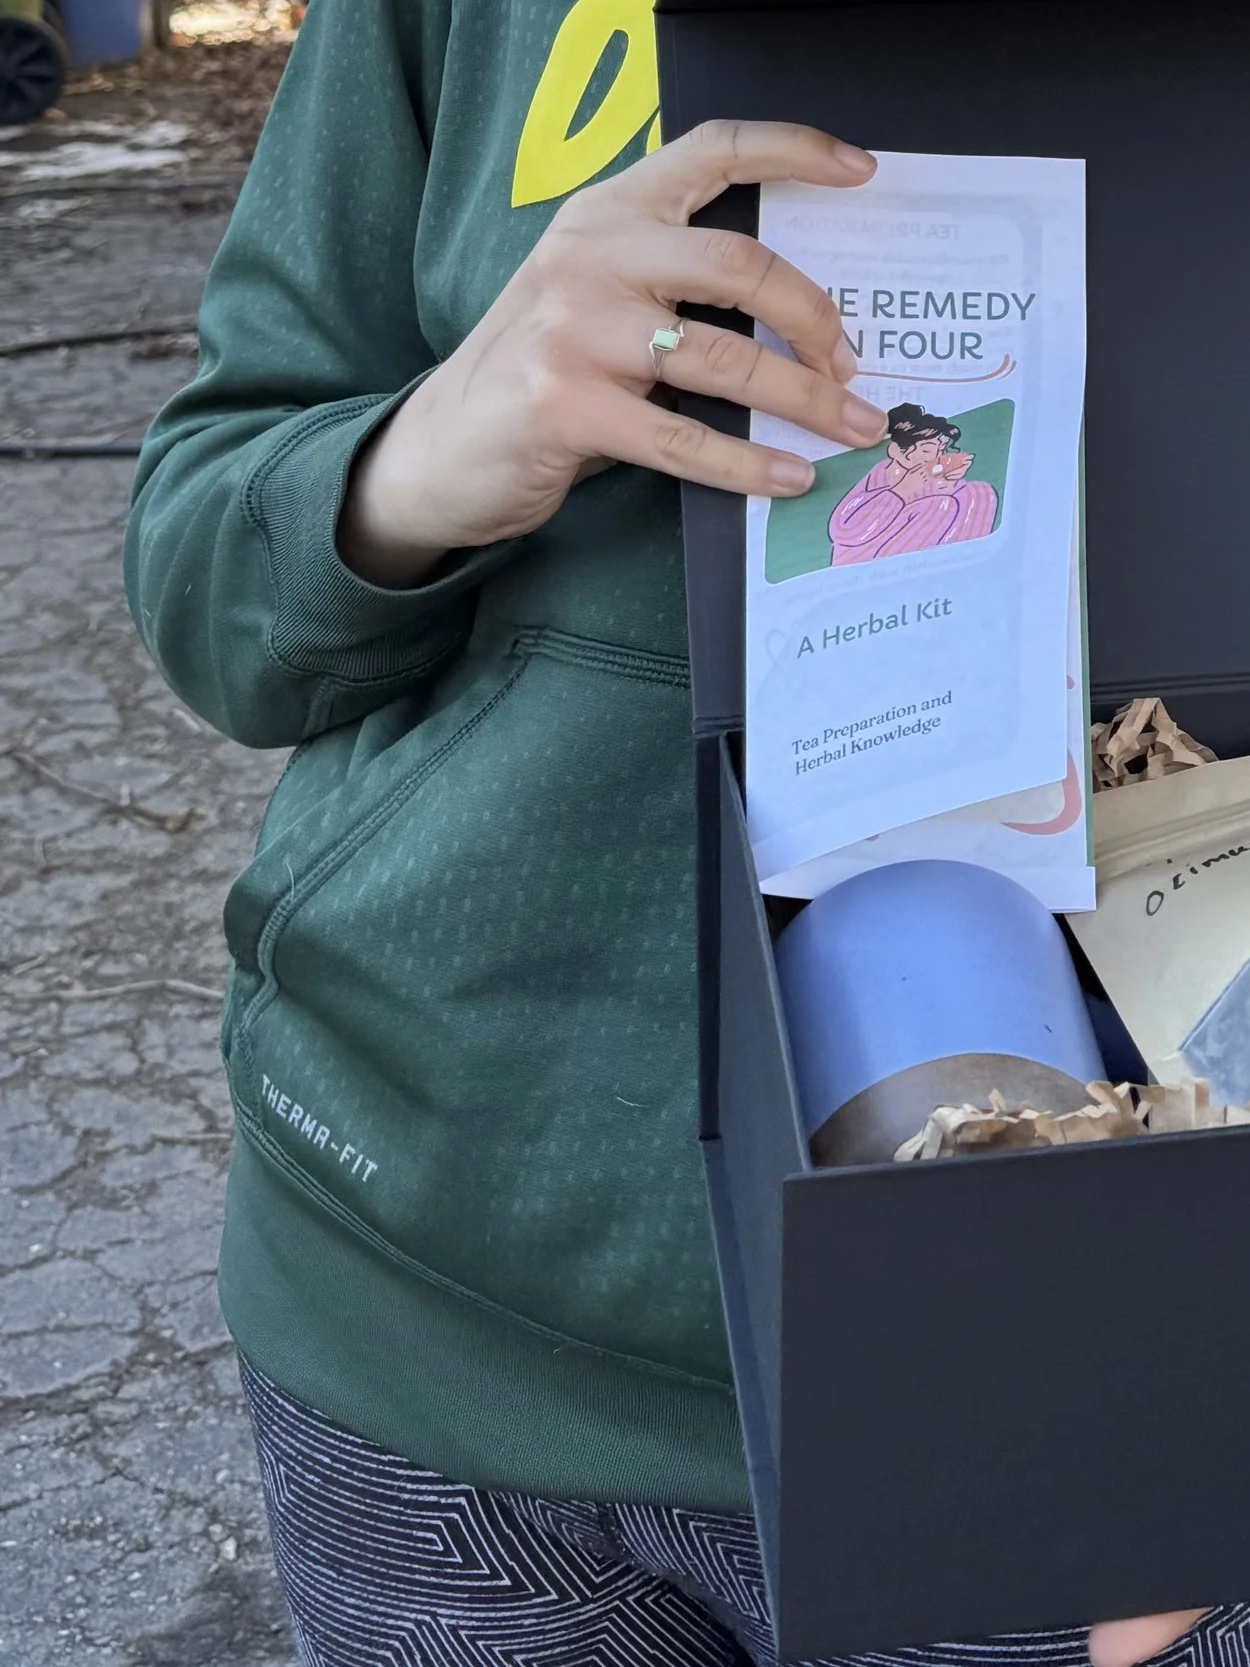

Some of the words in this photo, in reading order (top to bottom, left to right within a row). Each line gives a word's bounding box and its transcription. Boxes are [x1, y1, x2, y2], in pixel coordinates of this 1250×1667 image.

[872, 289, 1037, 322] REMEDY
[878, 330, 984, 360] FOUR
[797, 636, 814, 659] A
[822, 604, 909, 649] Herbal
[916, 598, 953, 622] Kit
[791, 735, 819, 756] Tea
[823, 706, 918, 743] Preparation
[921, 690, 953, 711] and
[794, 743, 847, 775] Herbal
[851, 716, 942, 755] Knowledge
[261, 1074, 379, 1183] THERMA-FIT
